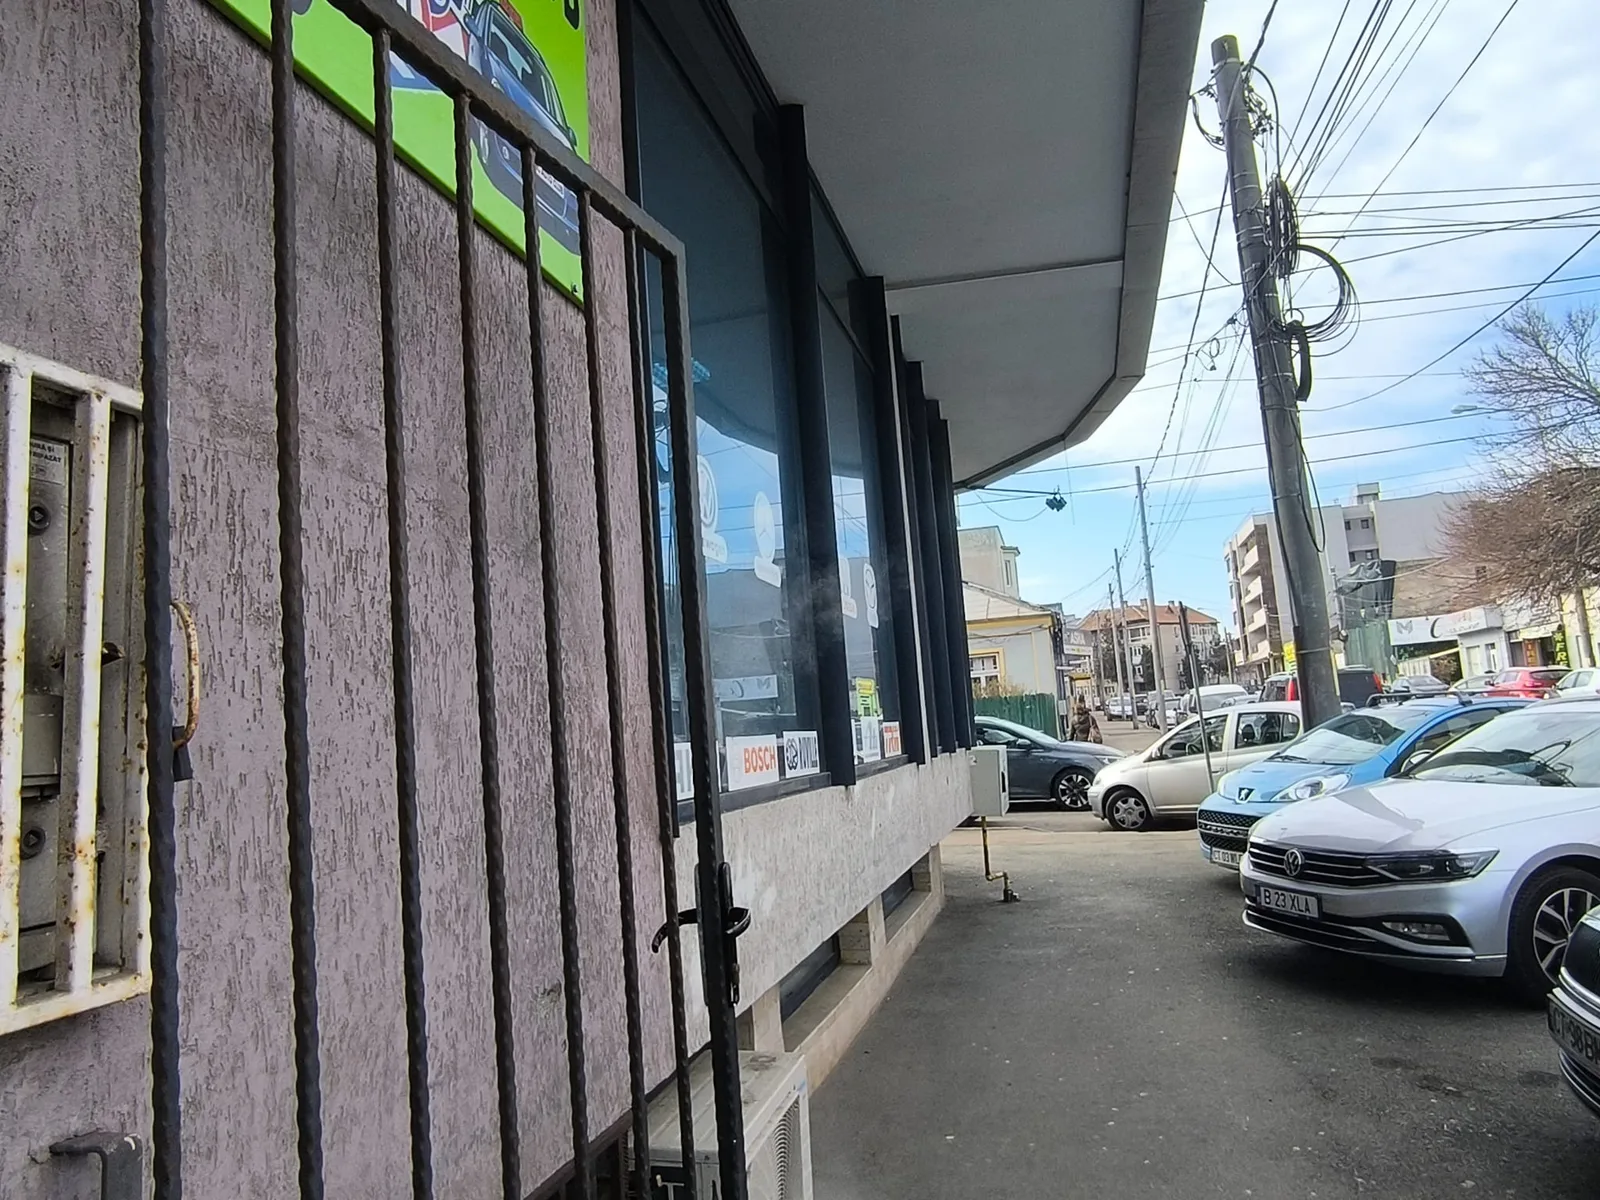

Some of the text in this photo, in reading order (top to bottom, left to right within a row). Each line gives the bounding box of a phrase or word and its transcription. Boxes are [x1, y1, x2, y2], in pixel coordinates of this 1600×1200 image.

[744, 746, 776, 774] BOSCH
[1263, 888, 1311, 914] B 23 XLA
